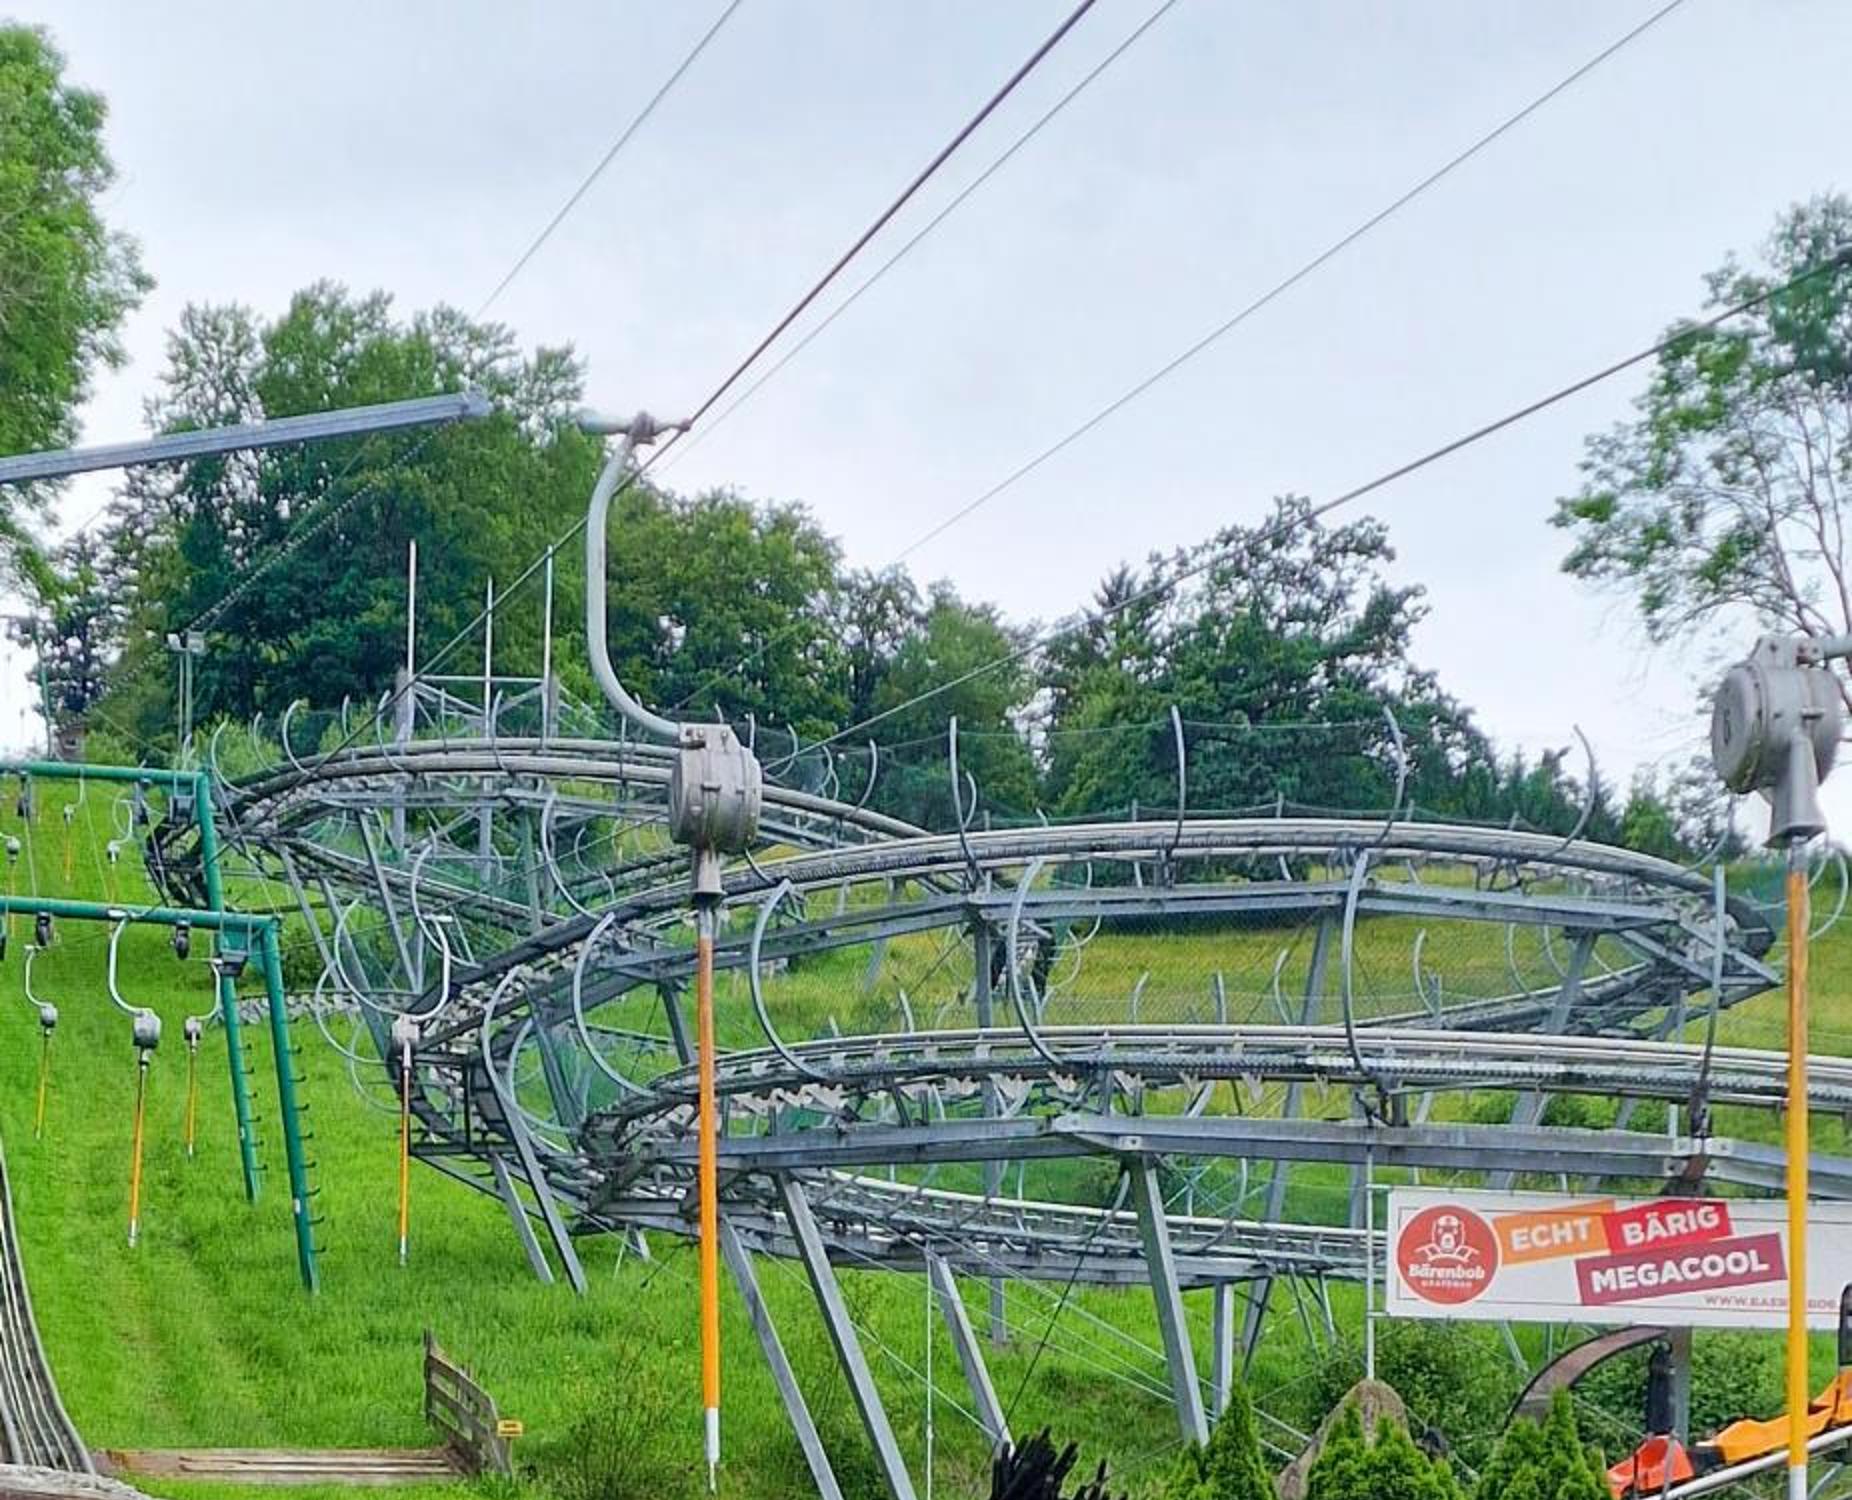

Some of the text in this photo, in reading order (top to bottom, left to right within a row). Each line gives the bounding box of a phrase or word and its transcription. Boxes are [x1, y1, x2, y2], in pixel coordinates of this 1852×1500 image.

[1508, 1204, 1721, 1252] ECHT BÄRIG
[1408, 1263, 1485, 1280] Bärenbob
[1591, 1248, 1770, 1294] MEGACOOL
